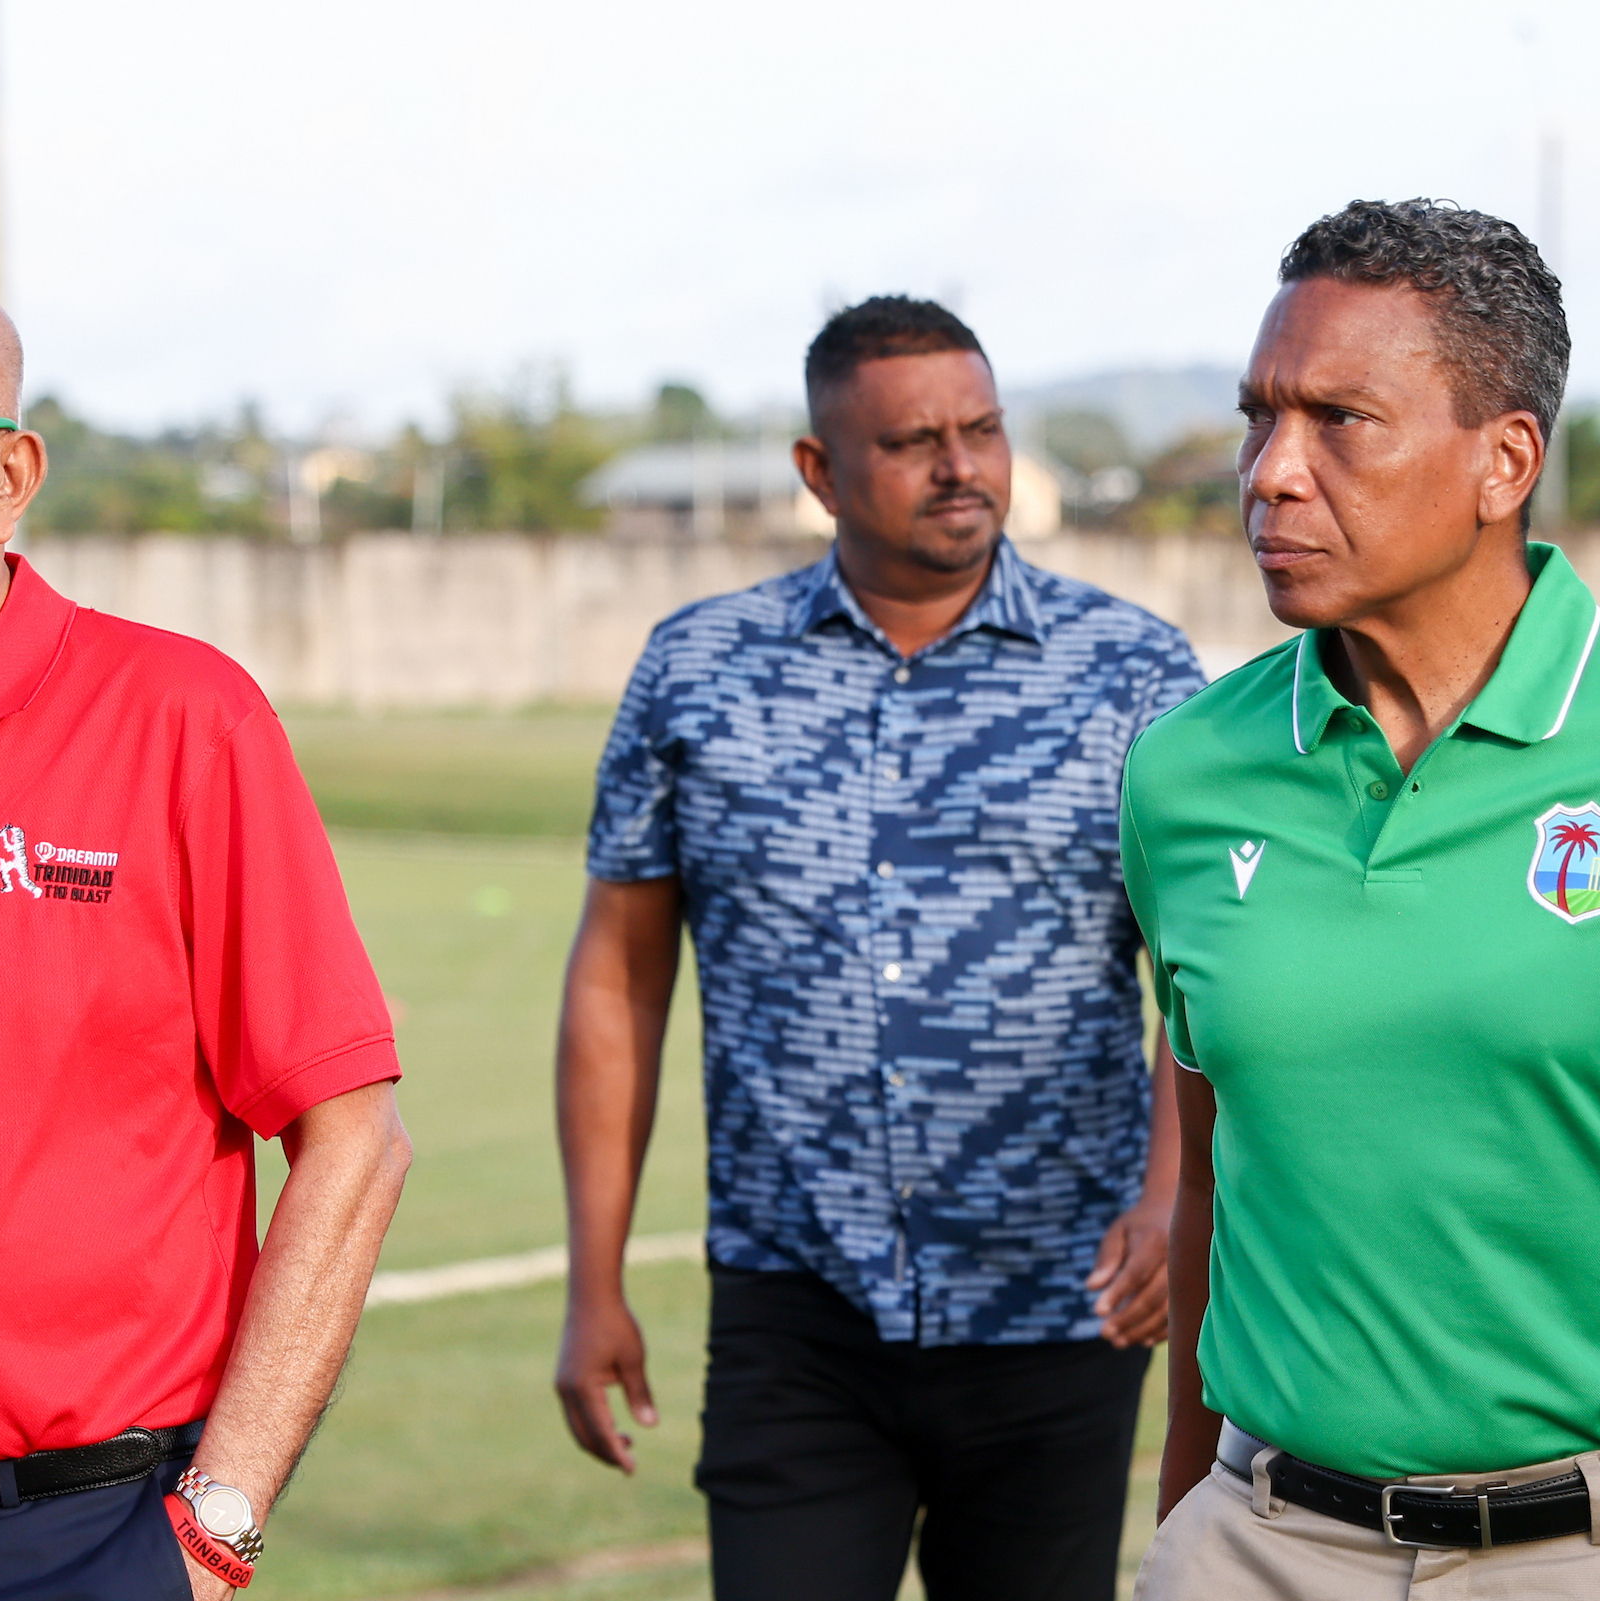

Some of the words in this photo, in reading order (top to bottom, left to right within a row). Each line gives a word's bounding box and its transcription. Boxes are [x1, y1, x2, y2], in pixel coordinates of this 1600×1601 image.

[55, 847, 119, 866] DREAM11
[34, 864, 114, 887] TRINIDAD
[45, 885, 67, 899] T10
[71, 887, 112, 903] BLAST
[177, 1518, 250, 1584] TRINBAGO
